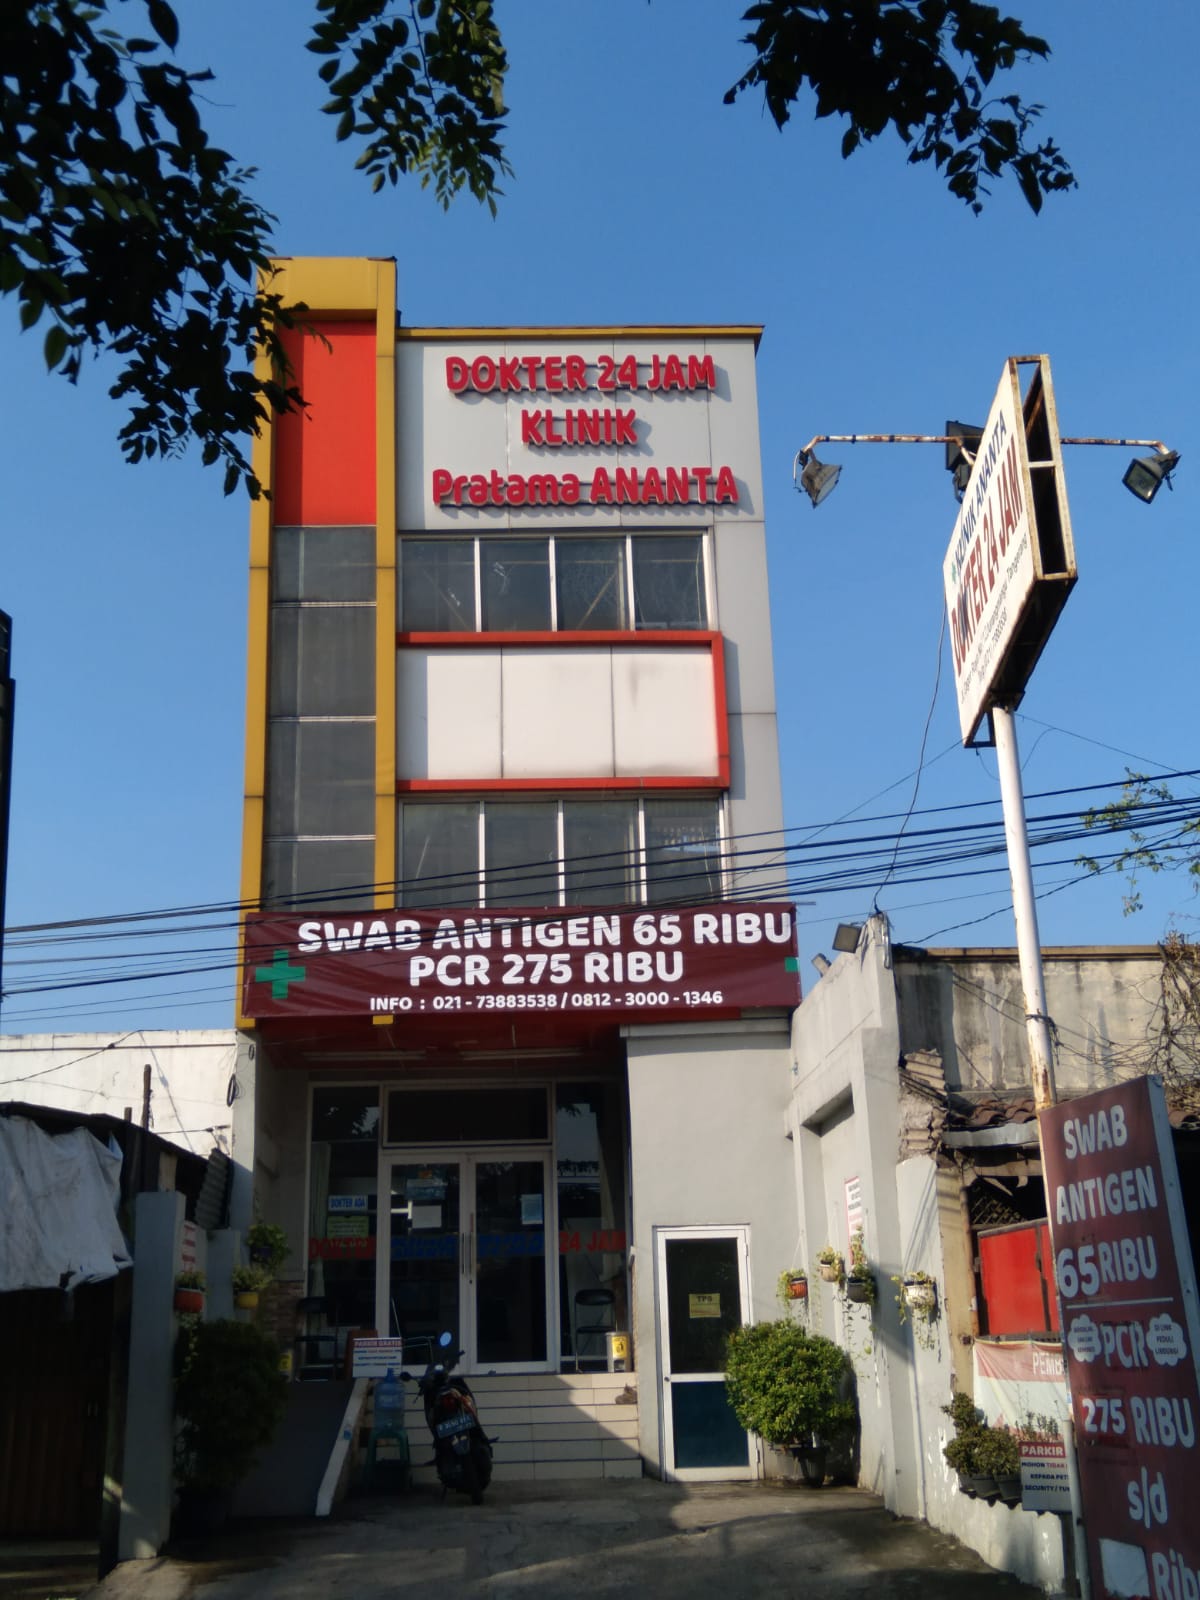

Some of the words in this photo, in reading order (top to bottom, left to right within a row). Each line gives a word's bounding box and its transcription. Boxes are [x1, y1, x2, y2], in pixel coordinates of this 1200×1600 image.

[446, 354, 588, 392] DOKTER
[597, 354, 638, 391] 24
[646, 353, 717, 391] JAM
[521, 408, 638, 445] KLINIK
[433, 468, 581, 506] Pratama
[590, 466, 739, 503] ANANTA
[955, 497, 977, 573] KLINIK
[976, 410, 1007, 511] ANANTA
[952, 533, 989, 677] DOKTER
[983, 495, 999, 593] 24
[997, 431, 1024, 557] JAM
[298, 919, 423, 952] SWAB
[432, 914, 622, 949] ANTIGEN
[633, 914, 683, 946] 65
[693, 911, 793, 945] RIBU
[409, 954, 491, 987] PCR
[501, 952, 573, 986] 275
[584, 950, 684, 984] RIBU
[370, 996, 413, 1010] INFO
[1063, 1104, 1128, 1160] SWAB
[1056, 1165, 1158, 1225] ANTIGEN
[559, 1230, 581, 1253] 24
[1032, 1351, 1064, 1376] PEMB
[1100, 1320, 1149, 1369] PCR
[1082, 1397, 1126, 1435] 275
[1130, 1396, 1195, 1449] RIBU
[1021, 1445, 1064, 1456] PARKIR
[1151, 1547, 1200, 1600] Rib
